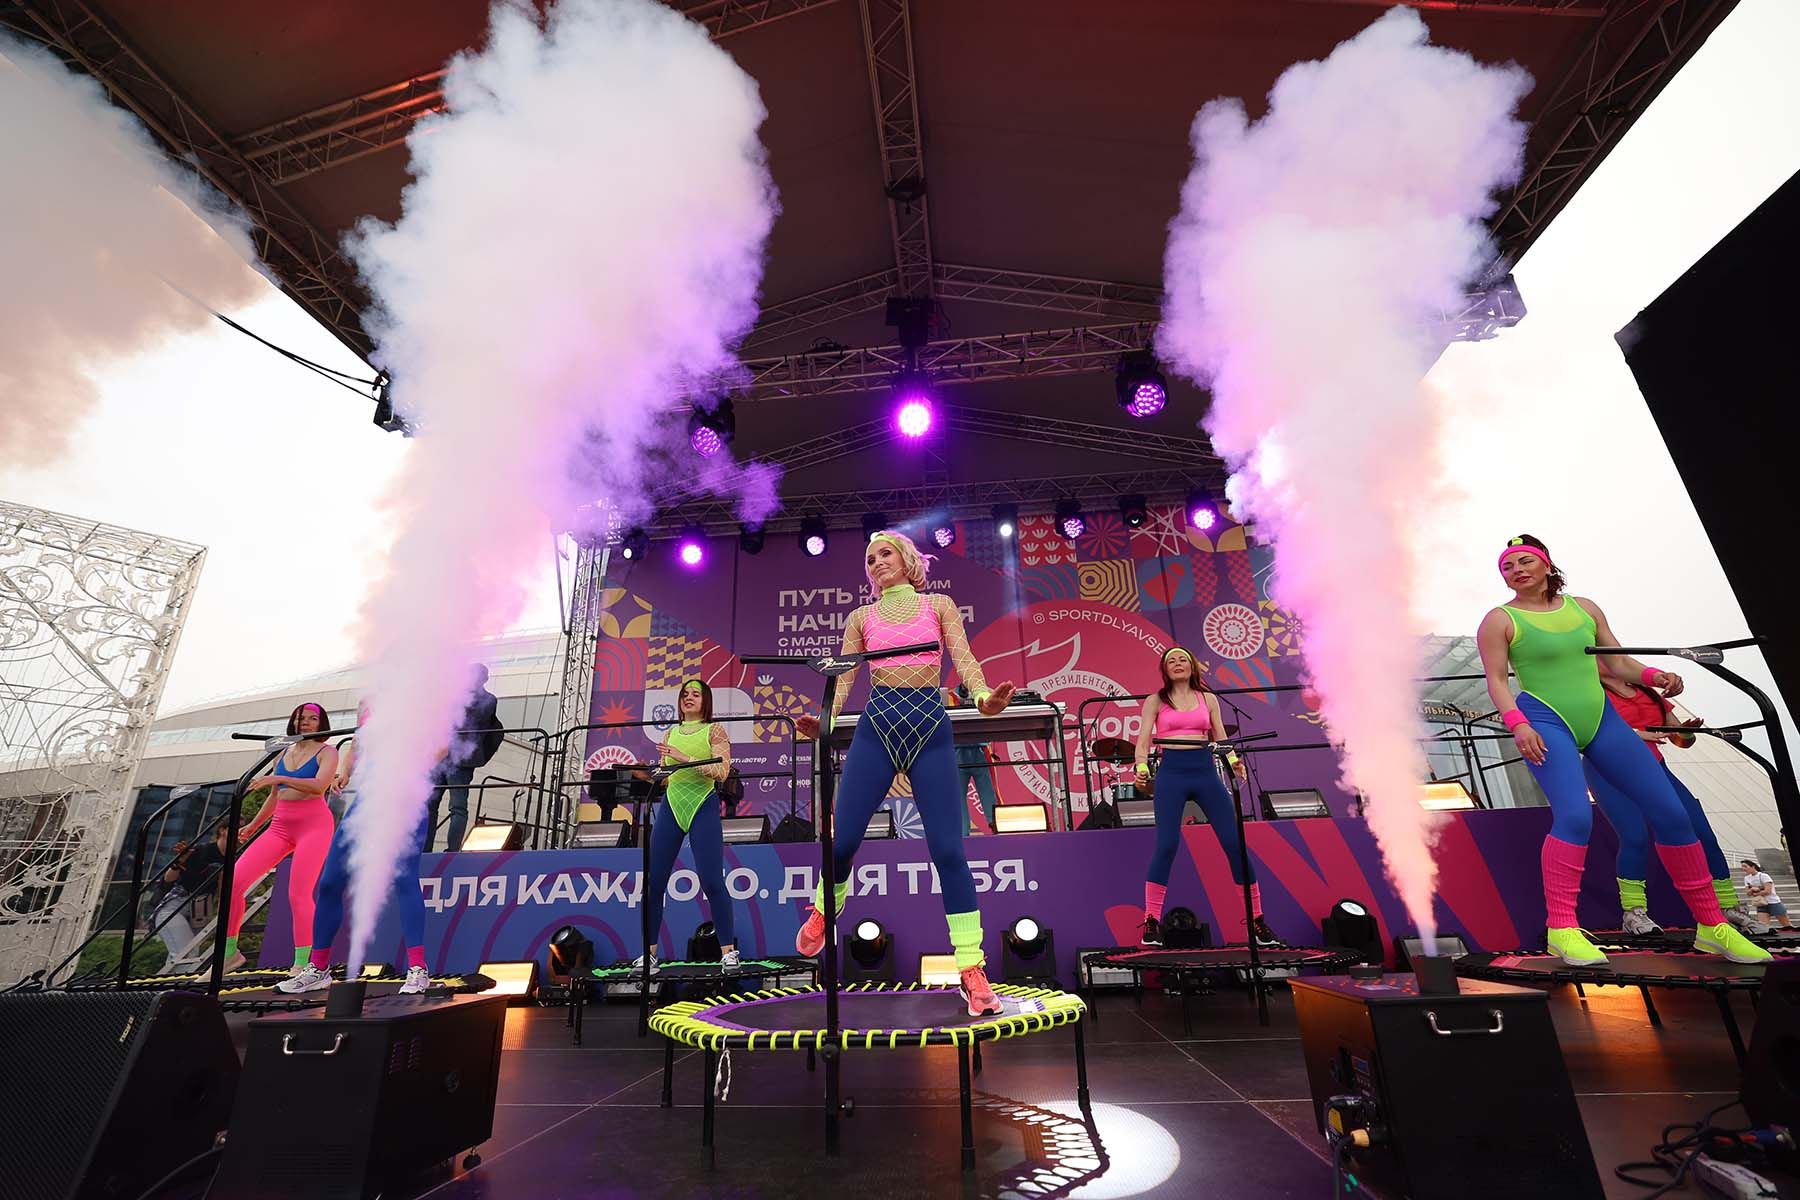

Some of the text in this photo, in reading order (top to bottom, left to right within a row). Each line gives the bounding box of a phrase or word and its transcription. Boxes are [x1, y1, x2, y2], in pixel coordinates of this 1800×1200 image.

[778, 588, 853, 608] ПУТЬ
[778, 635, 844, 647] С МАЛЕН
[1048, 609, 1167, 658] SPORTDLYAVSE
[778, 647, 832, 657] ШАГОВ
[1041, 674, 1126, 697] ПРЕЗИДЕНТСК
[419, 875, 508, 913] ДЛЯ
[517, 868, 769, 908] КАЖОО.
[778, 862, 888, 905] ДЯ
